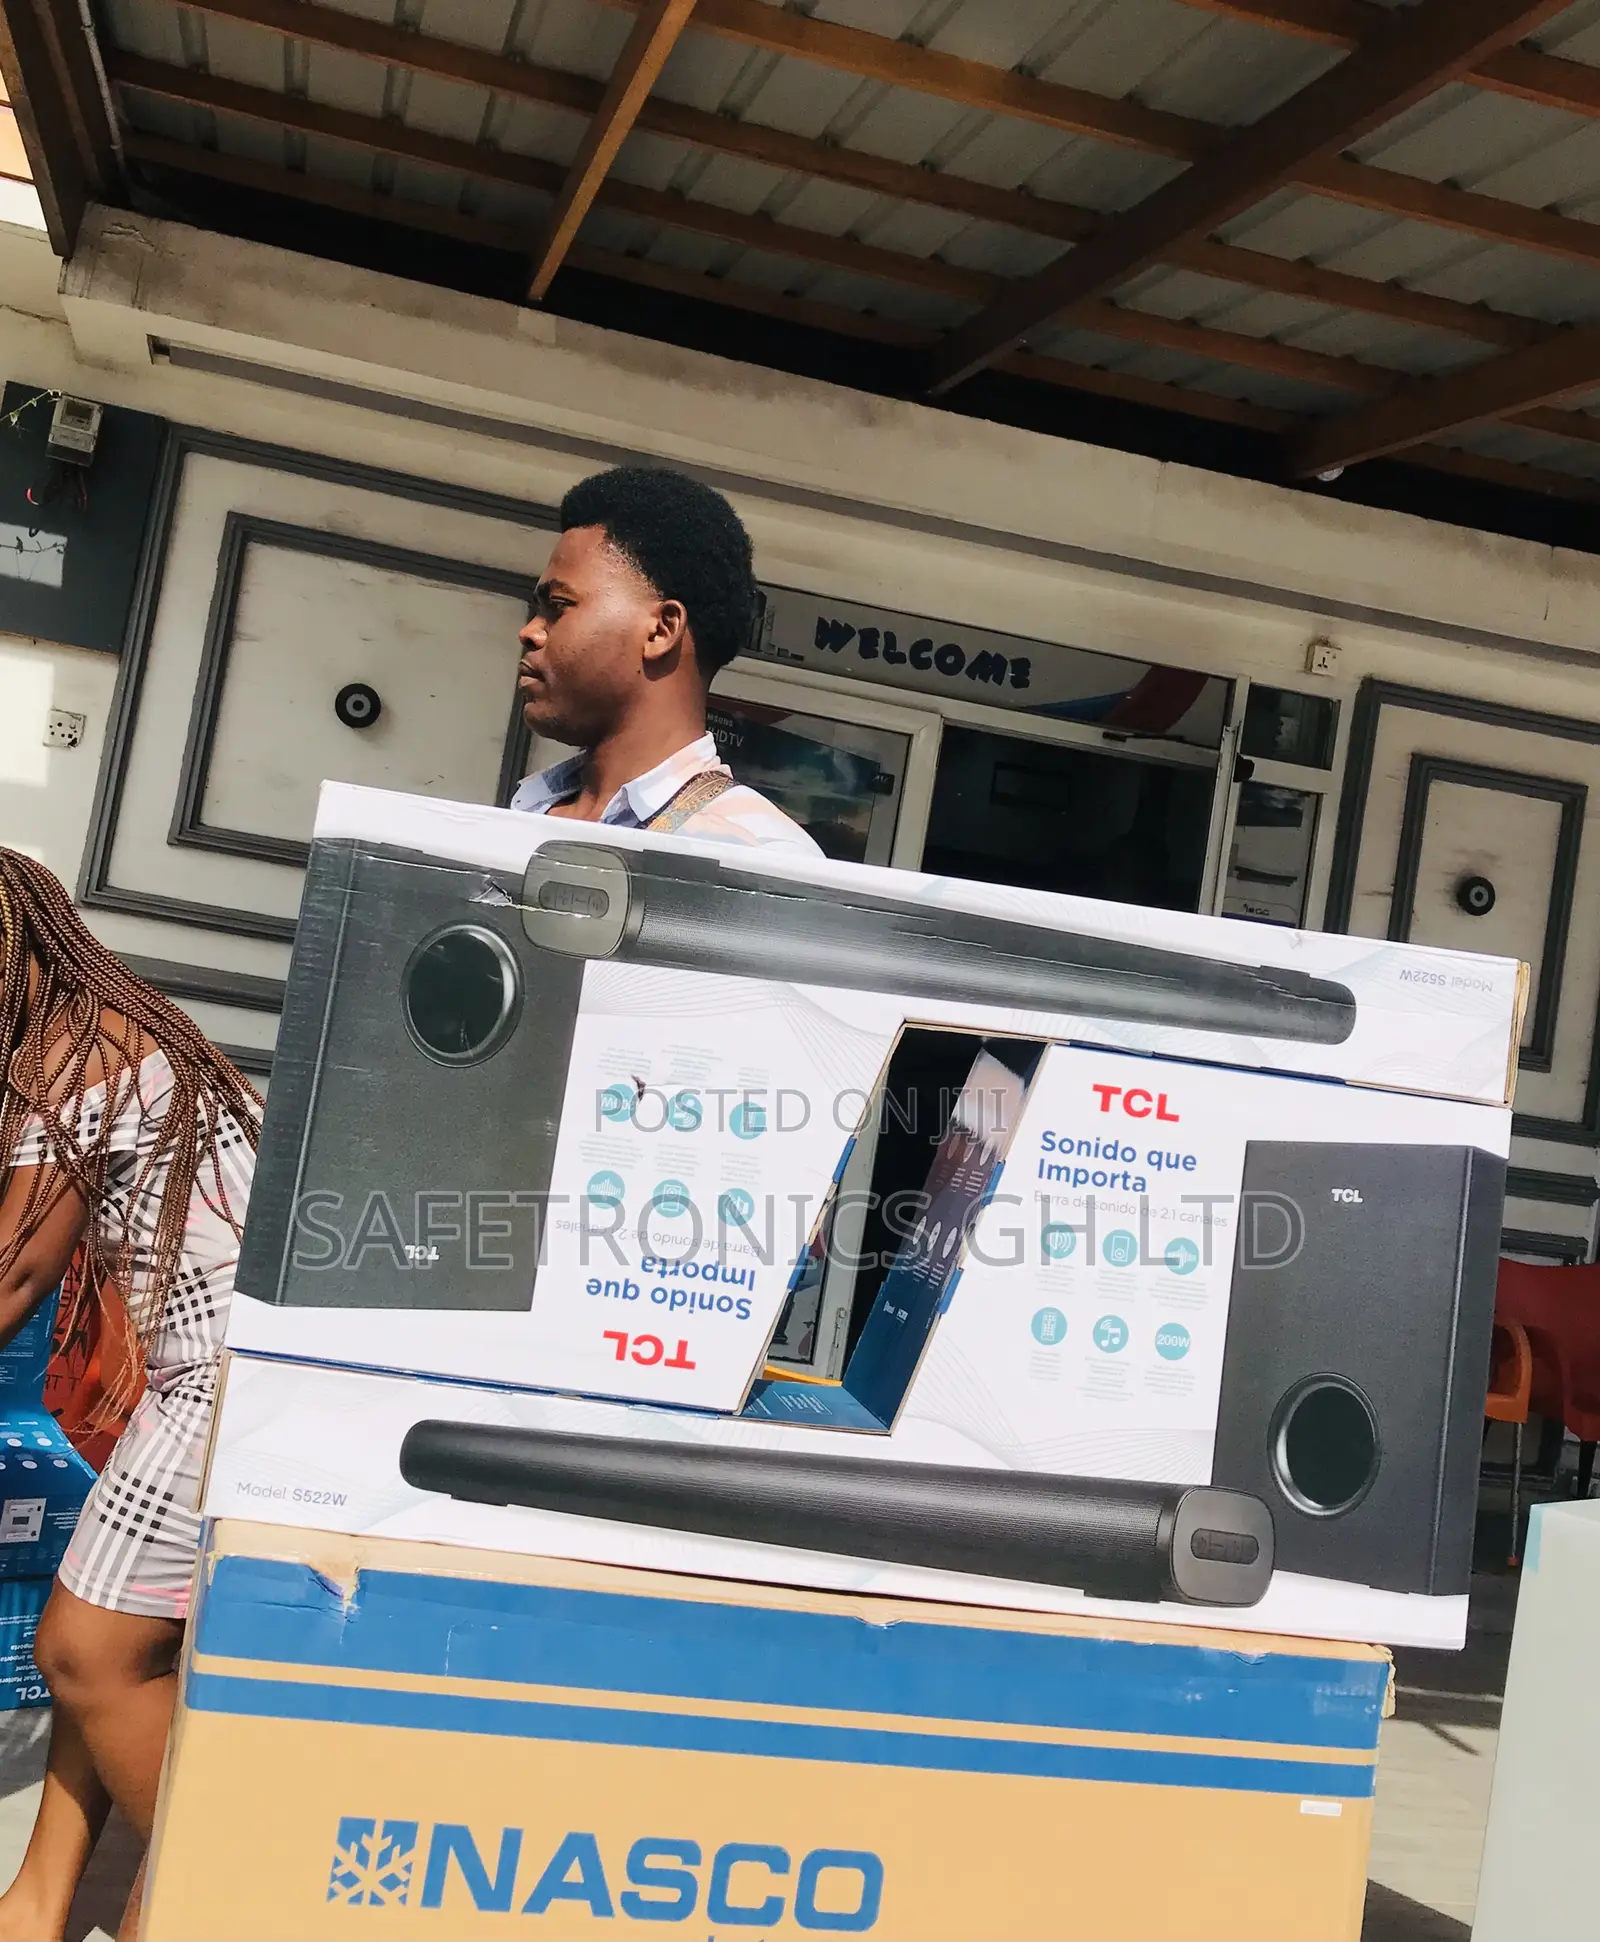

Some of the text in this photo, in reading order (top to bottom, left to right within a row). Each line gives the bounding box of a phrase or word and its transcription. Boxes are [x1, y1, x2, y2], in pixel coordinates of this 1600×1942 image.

[814, 616, 1031, 689] WELCOME
[1400, 968, 1494, 992] Model S522W
[1092, 1083, 1180, 1122] TCL
[1040, 1130, 1197, 1171] Sonido que
[1038, 1158, 1147, 1192] Importa
[1034, 1189, 1070, 1206] Barra
[1073, 1194, 1089, 1208] de
[1092, 1199, 1137, 1216] sonido
[1160, 1206, 1176, 1219] 2.1
[1180, 1210, 1228, 1227] canales
[1331, 1187, 1363, 1203] TCL
[404, 1244, 440, 1261] TCL
[653, 1231, 699, 1248] sonido
[641, 1255, 756, 1291] Importa
[586, 1278, 753, 1320] Sonido que
[603, 1330, 697, 1370] TCL
[1156, 1333, 1190, 1348] 200W
[237, 1481, 348, 1506] Model S522W
[15, 1685, 51, 1700] TCL
[420, 1822, 885, 1933] NASCO
